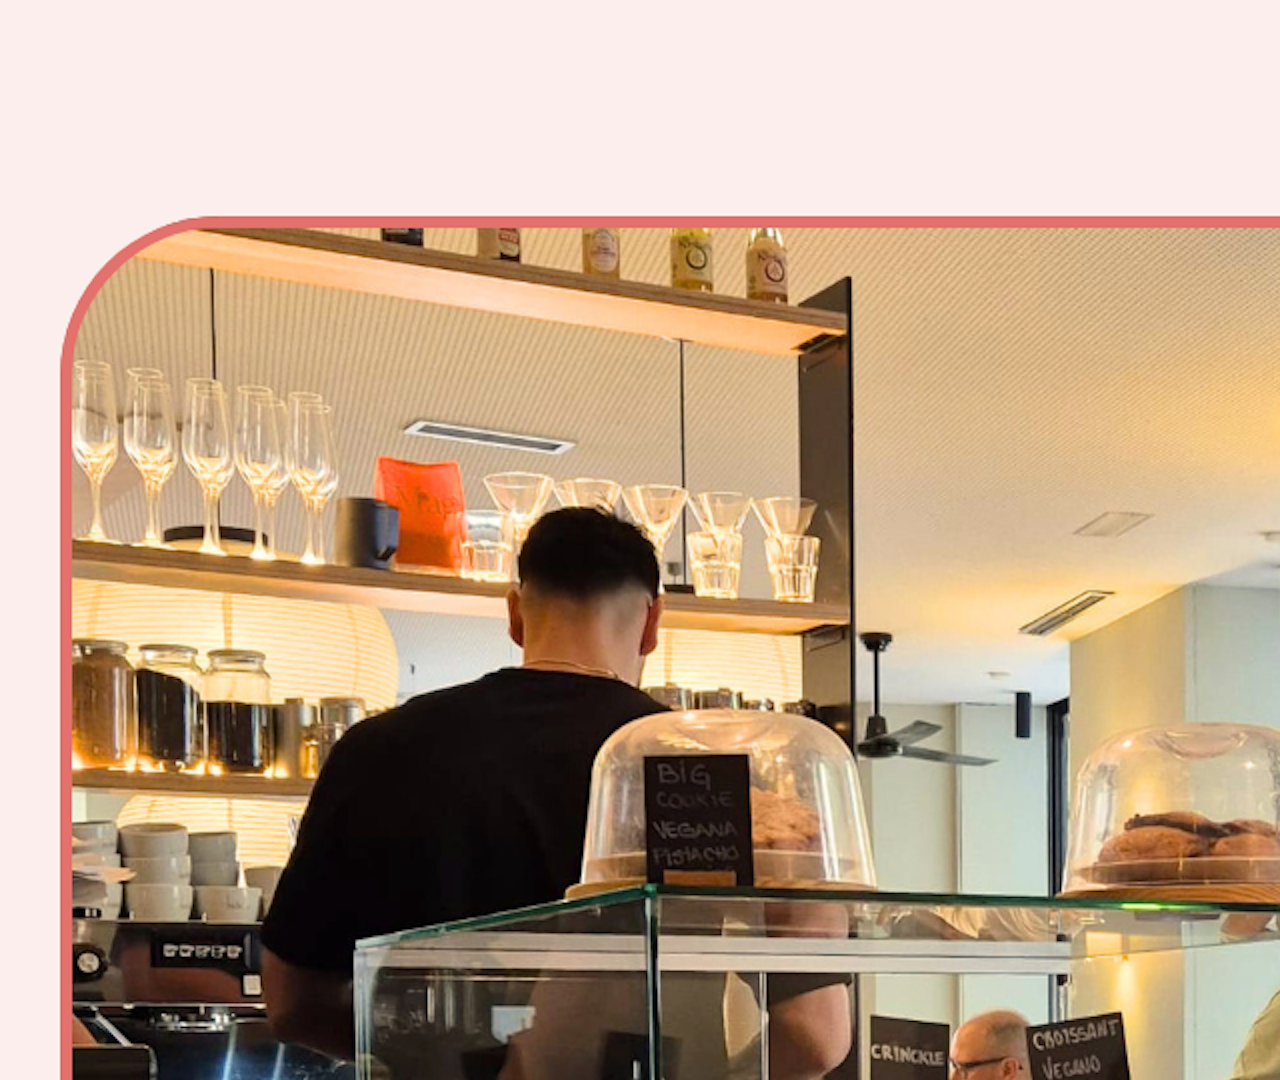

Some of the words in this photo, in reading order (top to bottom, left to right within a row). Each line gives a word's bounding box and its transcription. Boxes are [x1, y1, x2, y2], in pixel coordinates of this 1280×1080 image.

[652, 820, 738, 840] VEGANA
[1032, 1018, 1119, 1051] CROISSANT
[1042, 1053, 1101, 1080] VEGANO
